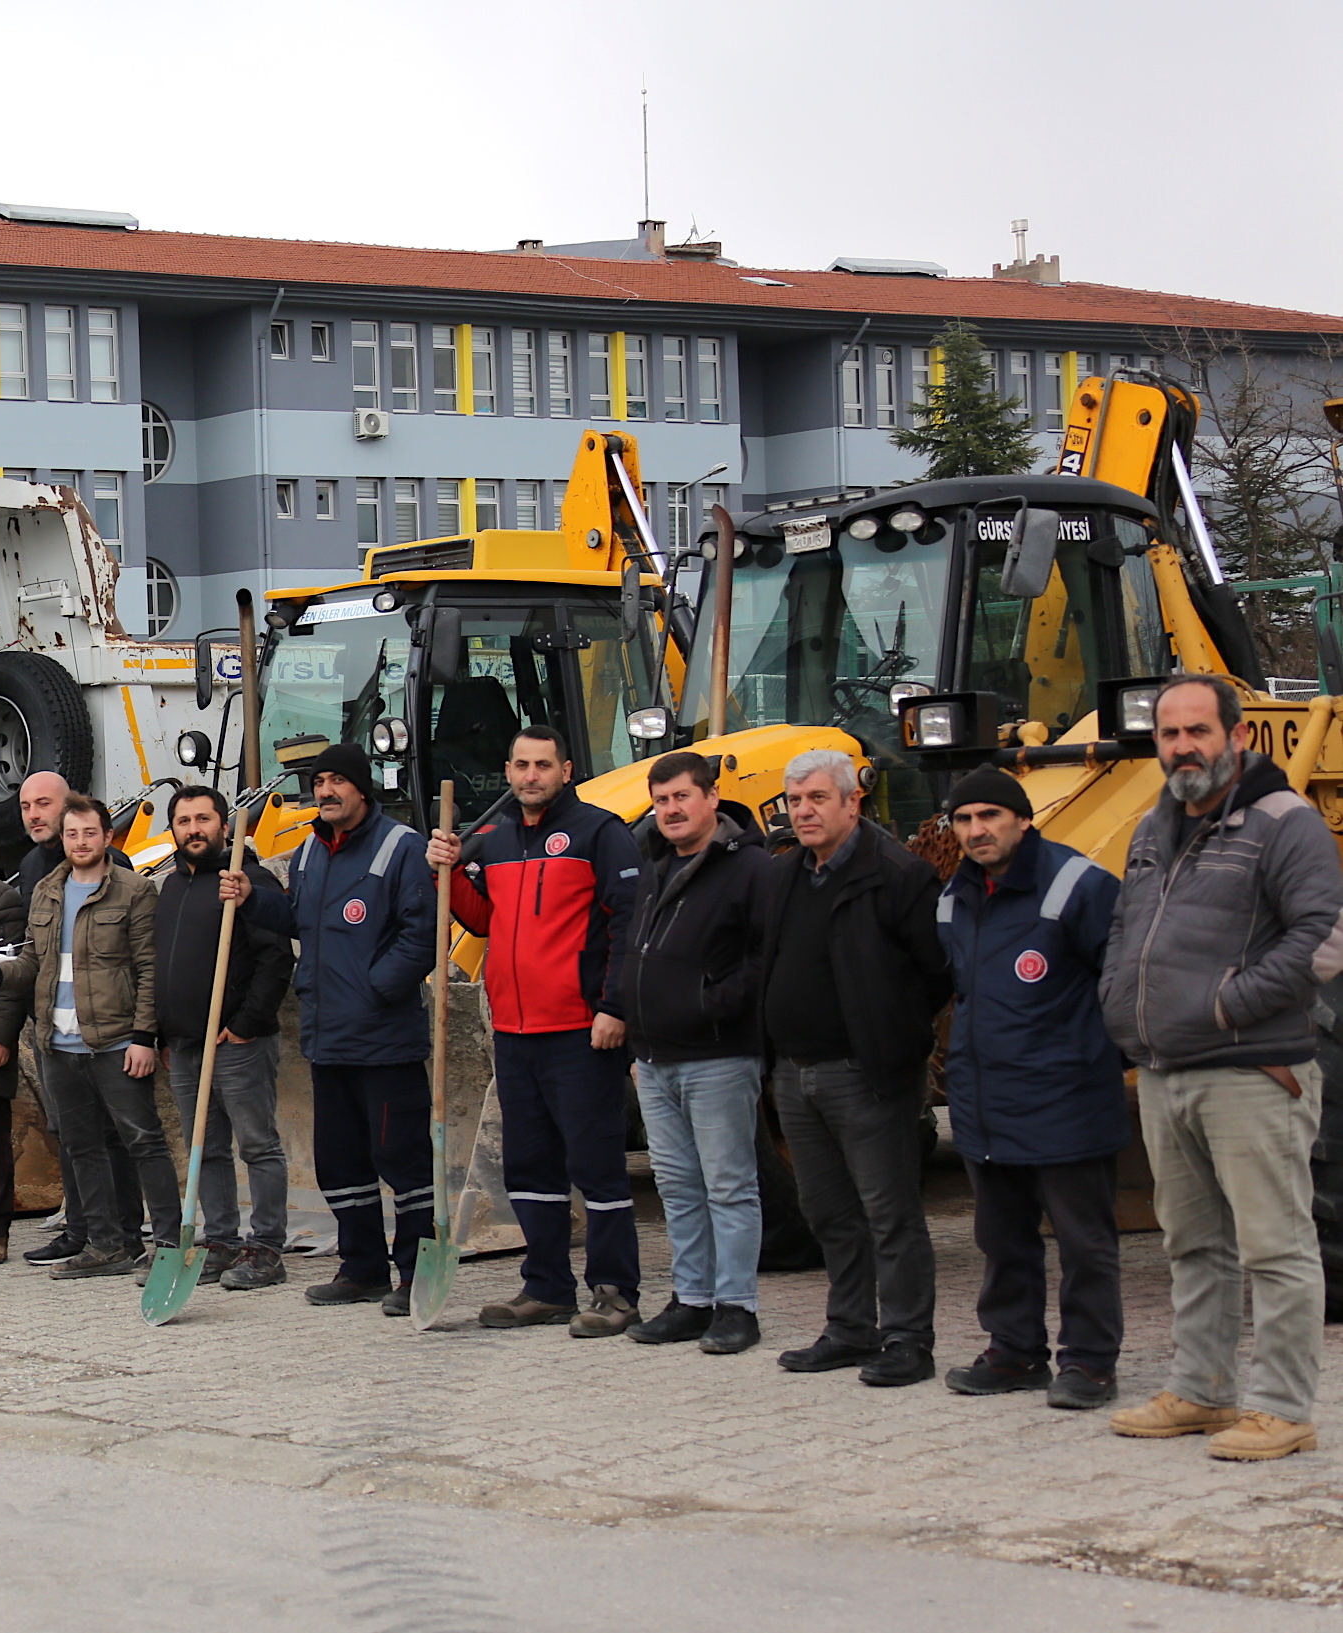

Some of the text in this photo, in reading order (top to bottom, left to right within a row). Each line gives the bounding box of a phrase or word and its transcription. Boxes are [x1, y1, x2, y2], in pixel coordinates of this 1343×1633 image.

[977, 516, 1091, 541] GÜRS İYESİ
[300, 611, 317, 622] FEN
